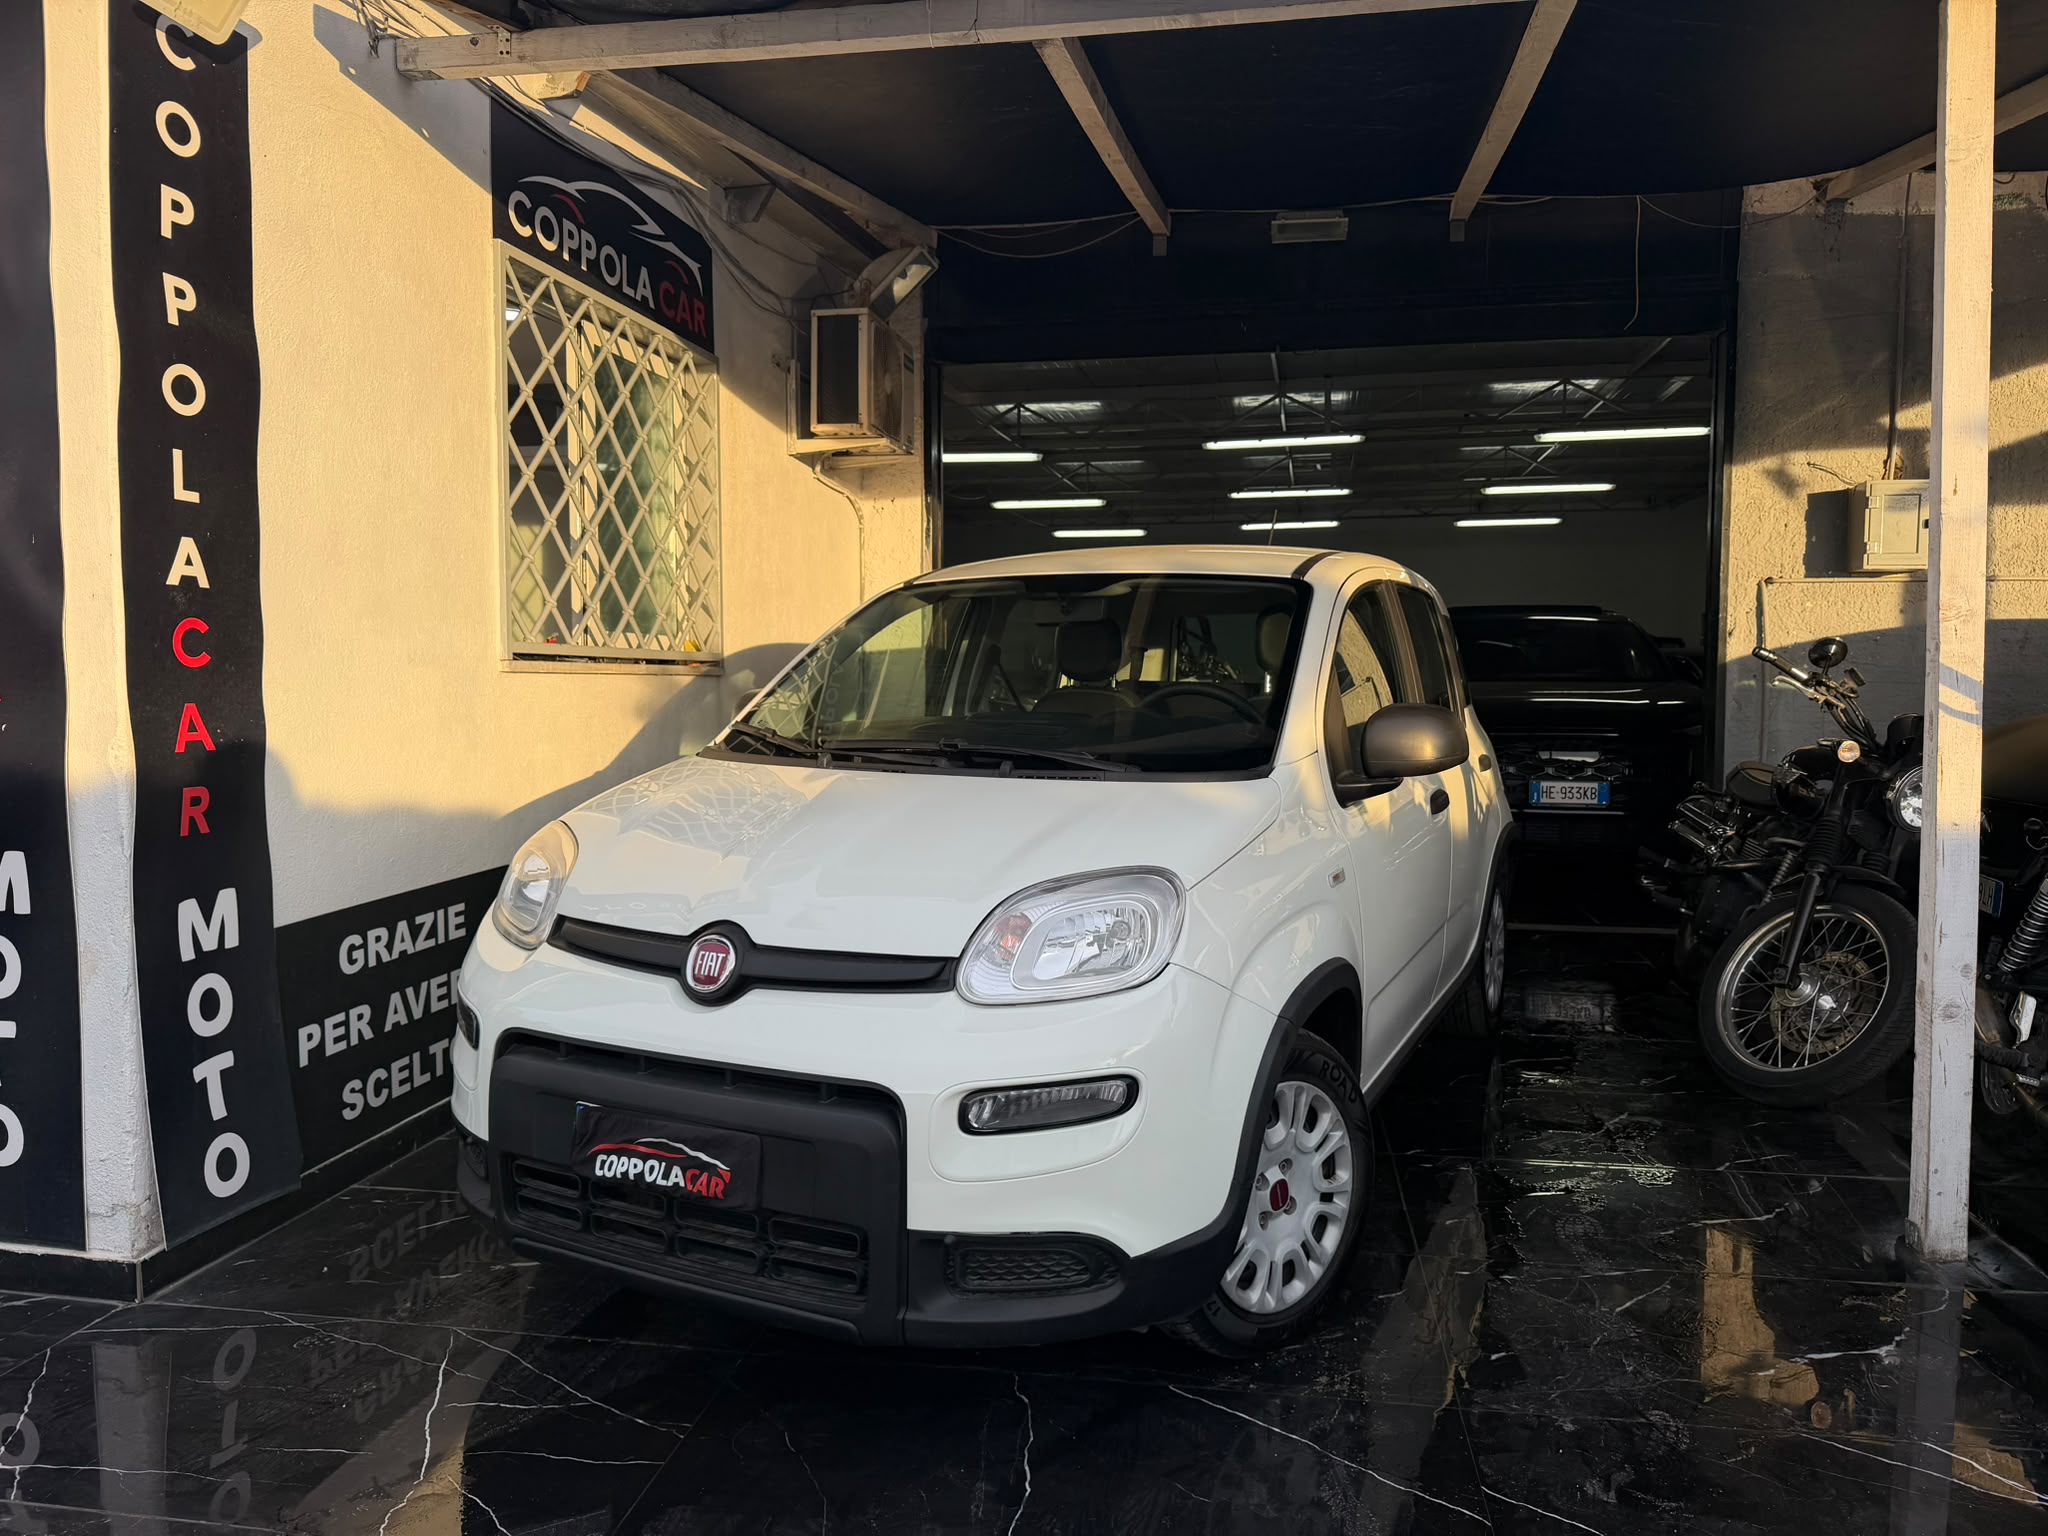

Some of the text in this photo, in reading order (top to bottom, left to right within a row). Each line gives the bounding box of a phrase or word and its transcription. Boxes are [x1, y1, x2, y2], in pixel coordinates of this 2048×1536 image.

[339, 902, 467, 976] GRAZIE
[694, 950, 726, 977] FIAT
[177, 887, 252, 1199] MOTO
[298, 1004, 374, 1068] PER
[341, 1037, 450, 1121] SCELT
